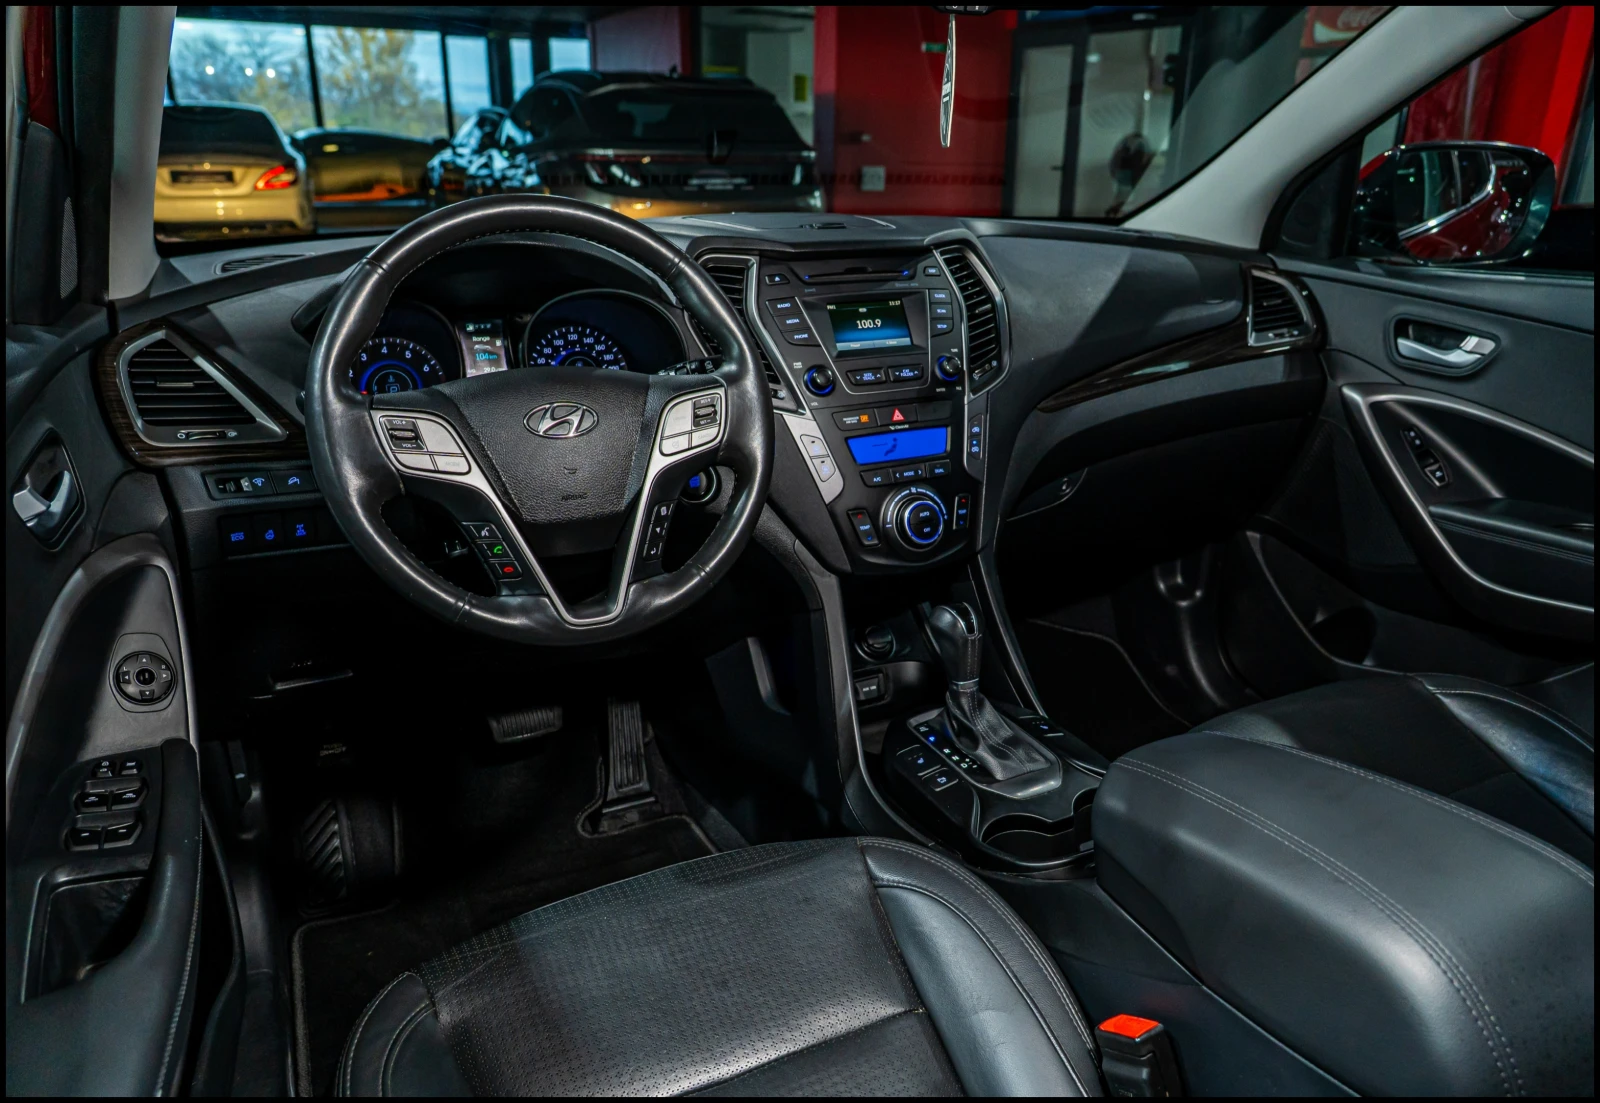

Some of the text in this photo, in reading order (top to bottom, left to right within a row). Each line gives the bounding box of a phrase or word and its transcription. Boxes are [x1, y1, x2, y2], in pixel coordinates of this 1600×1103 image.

[856, 318, 882, 329] 100.9
[381, 346, 388, 354] 4
[360, 353, 367, 361] 3
[405, 350, 412, 359] 5
[475, 352, 489, 361] 104
[423, 364, 430, 372] 6
